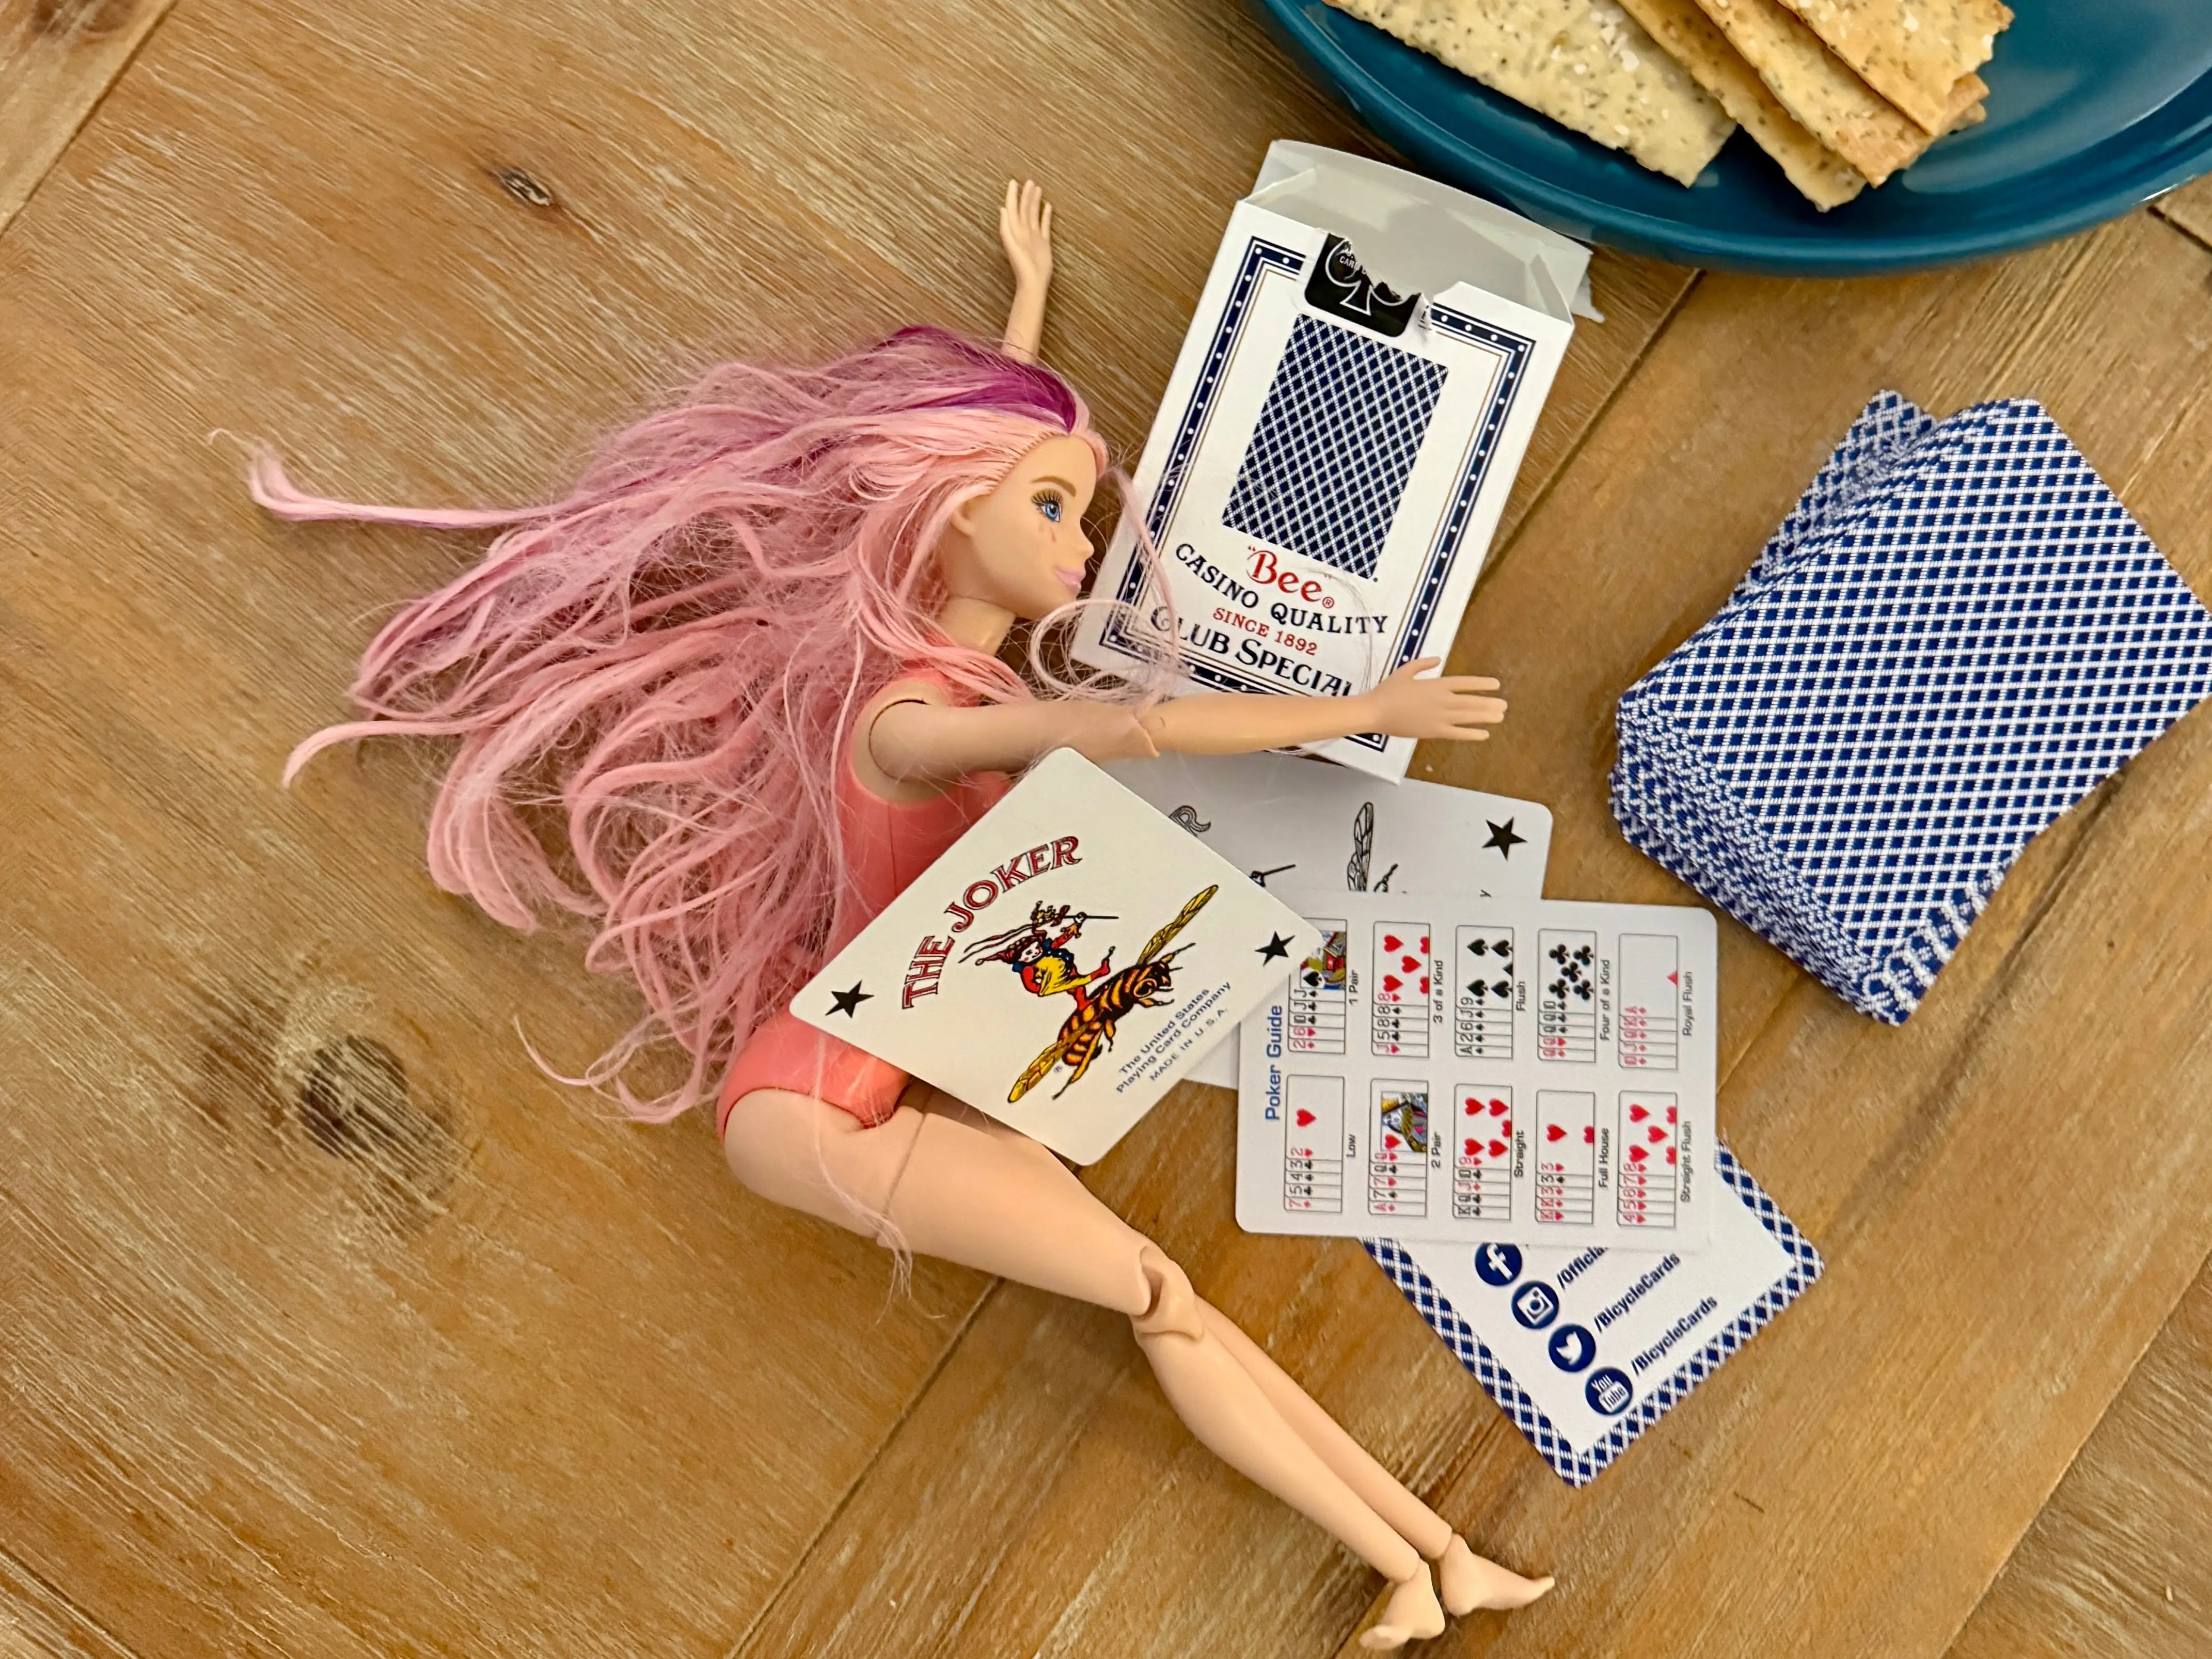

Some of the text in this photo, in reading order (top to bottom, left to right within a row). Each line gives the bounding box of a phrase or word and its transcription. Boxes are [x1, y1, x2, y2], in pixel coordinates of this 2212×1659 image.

[1176, 543, 1388, 634] CASINO QUALITY
[1213, 607, 1318, 656] SINCE 1892
[902, 836, 1083, 1009] THE JOKER
[1434, 960, 1443, 985] Kind
[1601, 959, 1610, 984] Kind
[1350, 970, 1358, 992] Pair
[1378, 992, 1390, 1001] 8
[1516, 981, 1526, 1011] Flush
[1433, 1000, 1443, 1010] of
[1544, 1001, 1556, 1009] 10
[1601, 999, 1610, 1010] of
[1683, 971, 1694, 1036] Royal Flush
[1461, 1009, 1474, 1018] J
[1625, 1005, 1637, 1014] A
[1294, 989, 1306, 1048] 2 6 10 J J
[1433, 1015, 1443, 1023] 3
[1119, 989, 1209, 1075] The United States
[1600, 1014, 1610, 1040] Four
[1116, 981, 1231, 1094] Playing Card Company
[1461, 1033, 1473, 1042] 2
[1378, 1044, 1389, 1053] J
[1461, 1045, 1473, 1054] A
[1543, 1048, 1556, 1056] Q
[1624, 1042, 1637, 1051] J
[1149, 1053, 1180, 1081] MADE
[1180, 1038, 1193, 1051] IN
[1265, 1005, 1282, 1120] Poker Guide
[1347, 1134, 1356, 1157] Low
[1431, 1132, 1441, 1168] 2 Pair
[1514, 1130, 1526, 1177] Straight
[1599, 1128, 1609, 1188] Full House
[1290, 1160, 1302, 1168] 3
[1459, 1156, 1472, 1164] 9
[1681, 1121, 1693, 1202] Straight Flush
[1459, 1170, 1471, 1178] 10
[1624, 1175, 1636, 1184] 7
[1374, 1177, 1386, 1186] 7
[1290, 1186, 1301, 1194] 5
[1374, 1190, 1386, 1198] 7
[1541, 1187, 1553, 1195] 3
[1290, 1199, 1301, 1207] 7
[1376, 1203, 1386, 1211] A
[1623, 1201, 1636, 1209] 5
[1459, 1206, 1471, 1215] K
[1623, 1214, 1636, 1223] 4
[1556, 1244, 1609, 1290] /Officia
[1593, 1252, 1681, 1334] /BicycleCards
[1630, 1295, 1718, 1377] /BicycleCards
[1590, 1374, 1613, 1393] You
[1601, 1385, 1626, 1410] Tube
